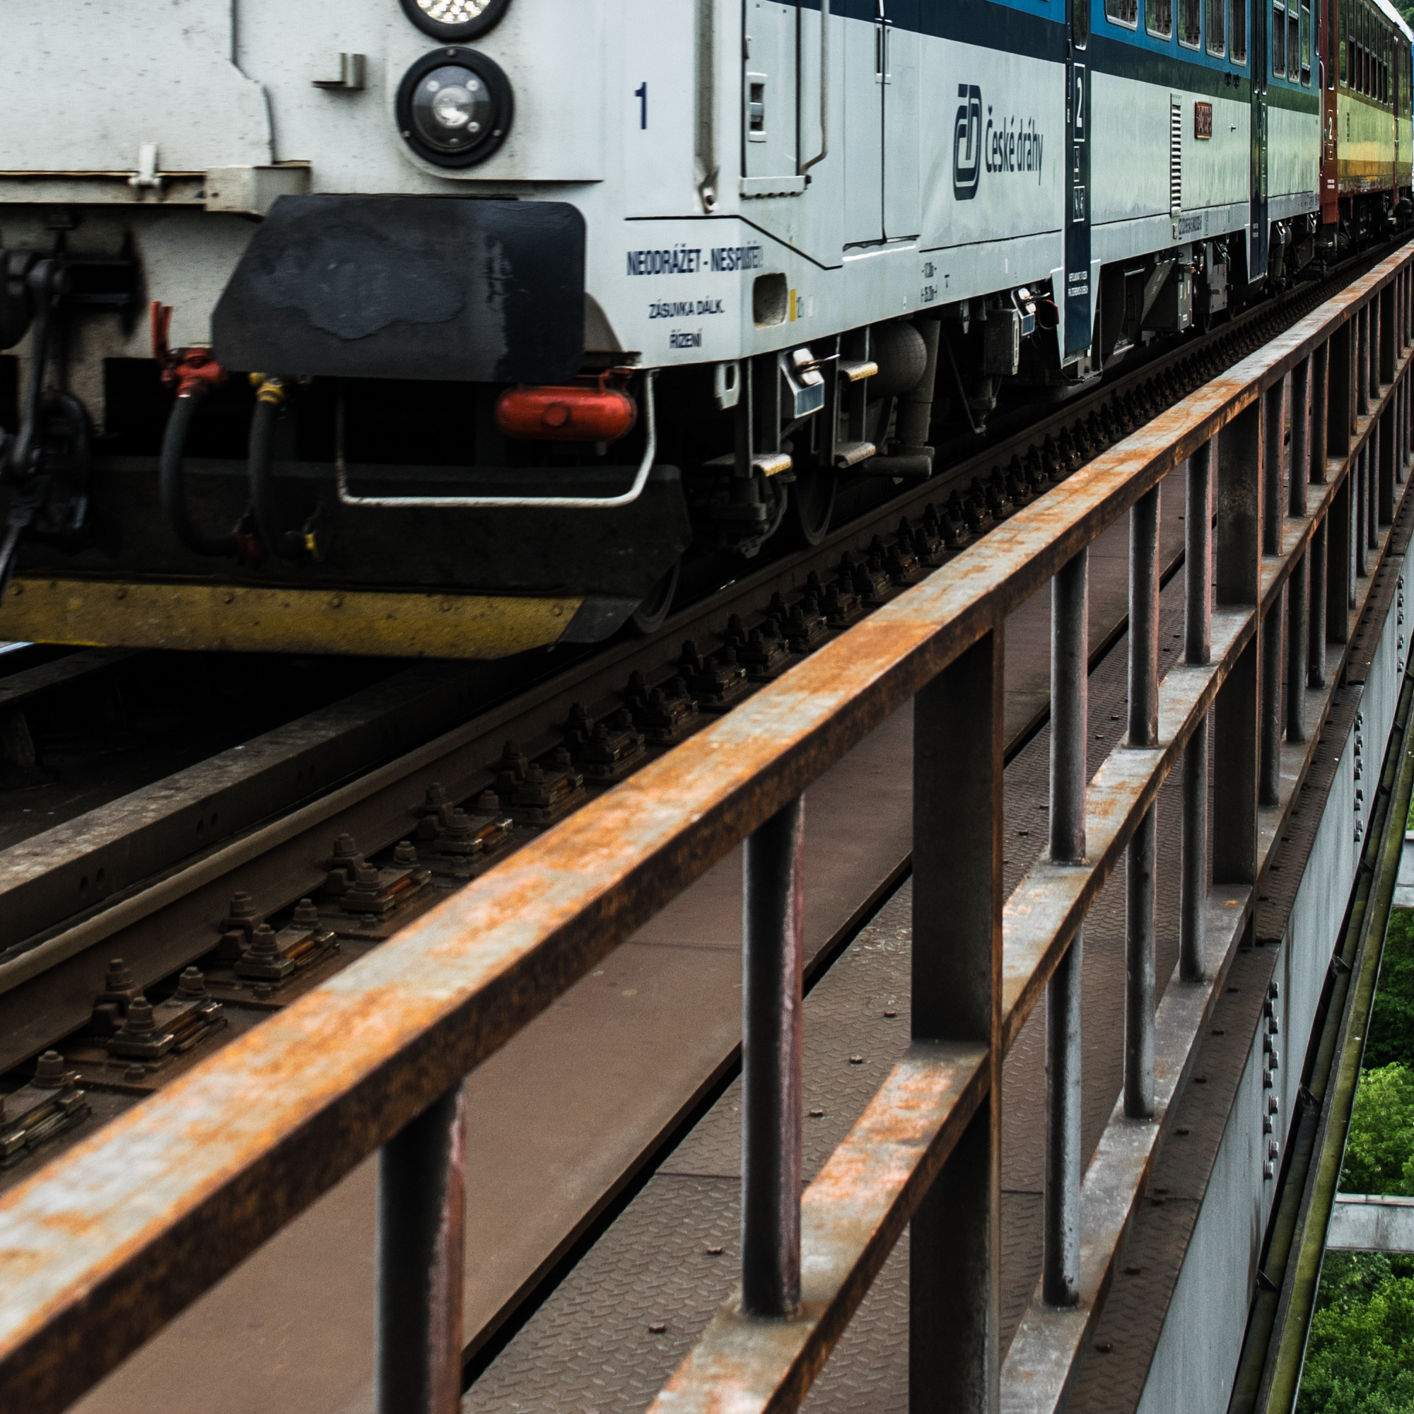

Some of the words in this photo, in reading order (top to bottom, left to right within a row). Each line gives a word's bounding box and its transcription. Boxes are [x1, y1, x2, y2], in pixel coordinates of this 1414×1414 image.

[634, 81, 648, 130] 1
[1076, 76, 1083, 128] 2
[985, 104, 1016, 174] České
[1016, 114, 1044, 187] dráhy
[627, 243, 702, 276] NEODRÁŽET
[649, 299, 694, 319] ZÁSUVKA
[696, 295, 725, 314] DÁLK.
[669, 328, 702, 349] ŘÍZENÍ
